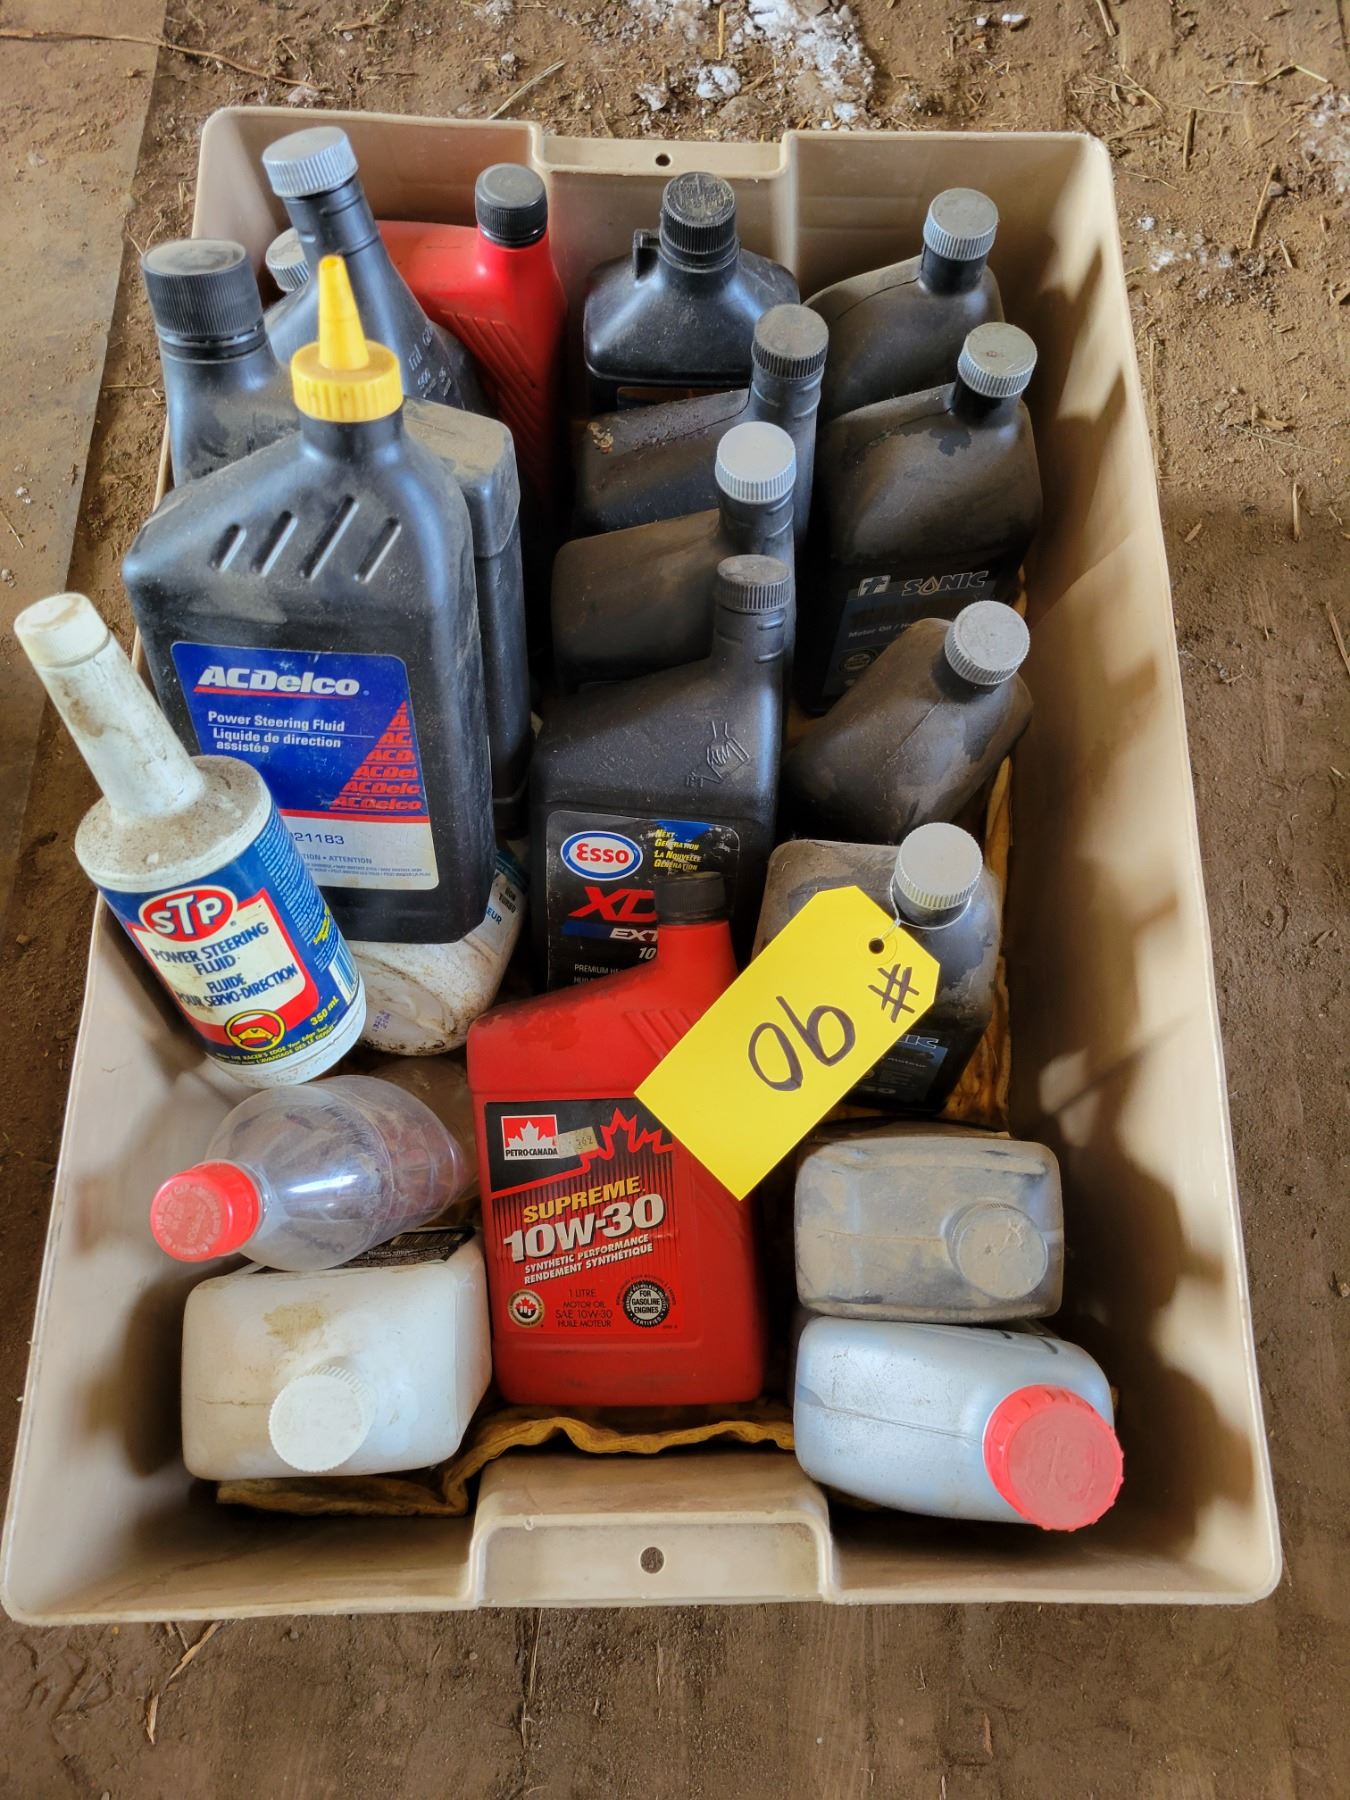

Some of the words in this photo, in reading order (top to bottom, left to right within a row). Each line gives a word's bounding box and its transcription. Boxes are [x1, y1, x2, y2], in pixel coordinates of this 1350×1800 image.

[196, 664, 360, 697] ACDelco
[207, 711, 251, 725] Power
[254, 715, 309, 732] Steering
[312, 719, 346, 732] Fluid
[212, 728, 260, 743] Liquide
[263, 732, 280, 743] de
[282, 733, 341, 748] direction
[216, 739, 270, 753] assistée
[291, 831, 345, 845] 21183
[328, 855, 373, 865] ATTENTION
[151, 894, 226, 936] STP
[200, 921, 269, 961] STEERING
[194, 954, 237, 976] FLUID
[574, 963, 610, 975] PREMIUM
[203, 962, 299, 1009] SERVO-DIRECTION
[205, 973, 247, 996] FLUIDE
[310, 1007, 329, 1026] 350
[505, 1146, 558, 1158] PETRO-CANADA
[523, 1176, 642, 1224] SUPREME
[503, 1193, 665, 1262] 10W-30
[524, 1263, 583, 1285] RENDEMENT
[586, 1243, 653, 1269] SYNTHÉTIQUE
[525, 1253, 575, 1274] SYNTHETIC
[577, 1234, 650, 1261] PERFORMANCE
[575, 1288, 597, 1298] LITRE
[555, 1310, 574, 1320] SAE
[577, 1309, 613, 1320] 10W-30
[562, 1301, 591, 1309] MOTOR
[633, 1306, 659, 1314] ENGINES
[578, 1320, 612, 1328] MOTEUR
